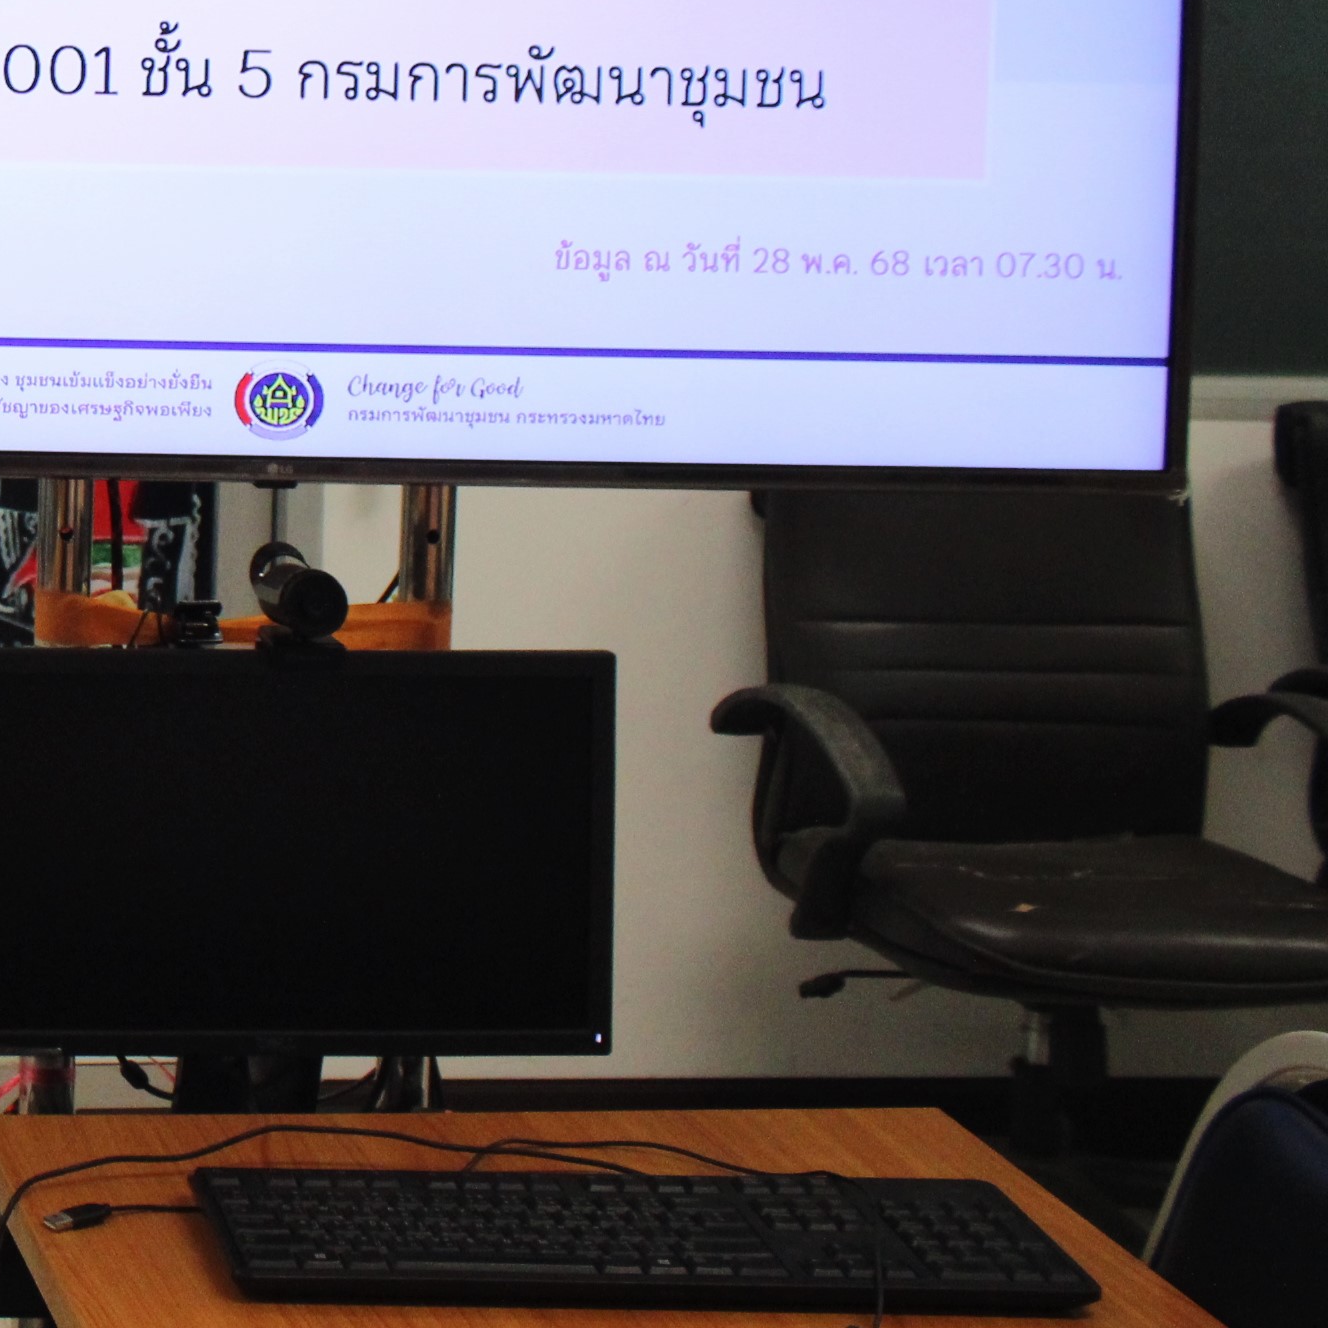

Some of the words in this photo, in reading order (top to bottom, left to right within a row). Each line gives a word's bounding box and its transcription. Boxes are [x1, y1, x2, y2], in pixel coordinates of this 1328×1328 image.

[141, 21, 212, 98] ชั้น
[239, 50, 272, 98] 5
[298, 45, 826, 128] กรมการพัฒนาชุมชน
[555, 239, 630, 282] ข้อมูล
[644, 250, 670, 272] ณ
[682, 236, 740, 273] วันที่
[753, 247, 790, 274] 28
[801, 253, 857, 274] พ.ค.
[870, 250, 910, 276] 68
[924, 255, 983, 277] เวลา
[995, 252, 1085, 280] 07.30
[1096, 259, 1122, 280] น.
[347, 375, 428, 403] Change
[432, 375, 466, 404] for
[470, 375, 524, 399] Good
[348, 407, 510, 429] กรมการพัฒนาชุมชน
[516, 409, 665, 427] กระทรวงมหาดไทย
